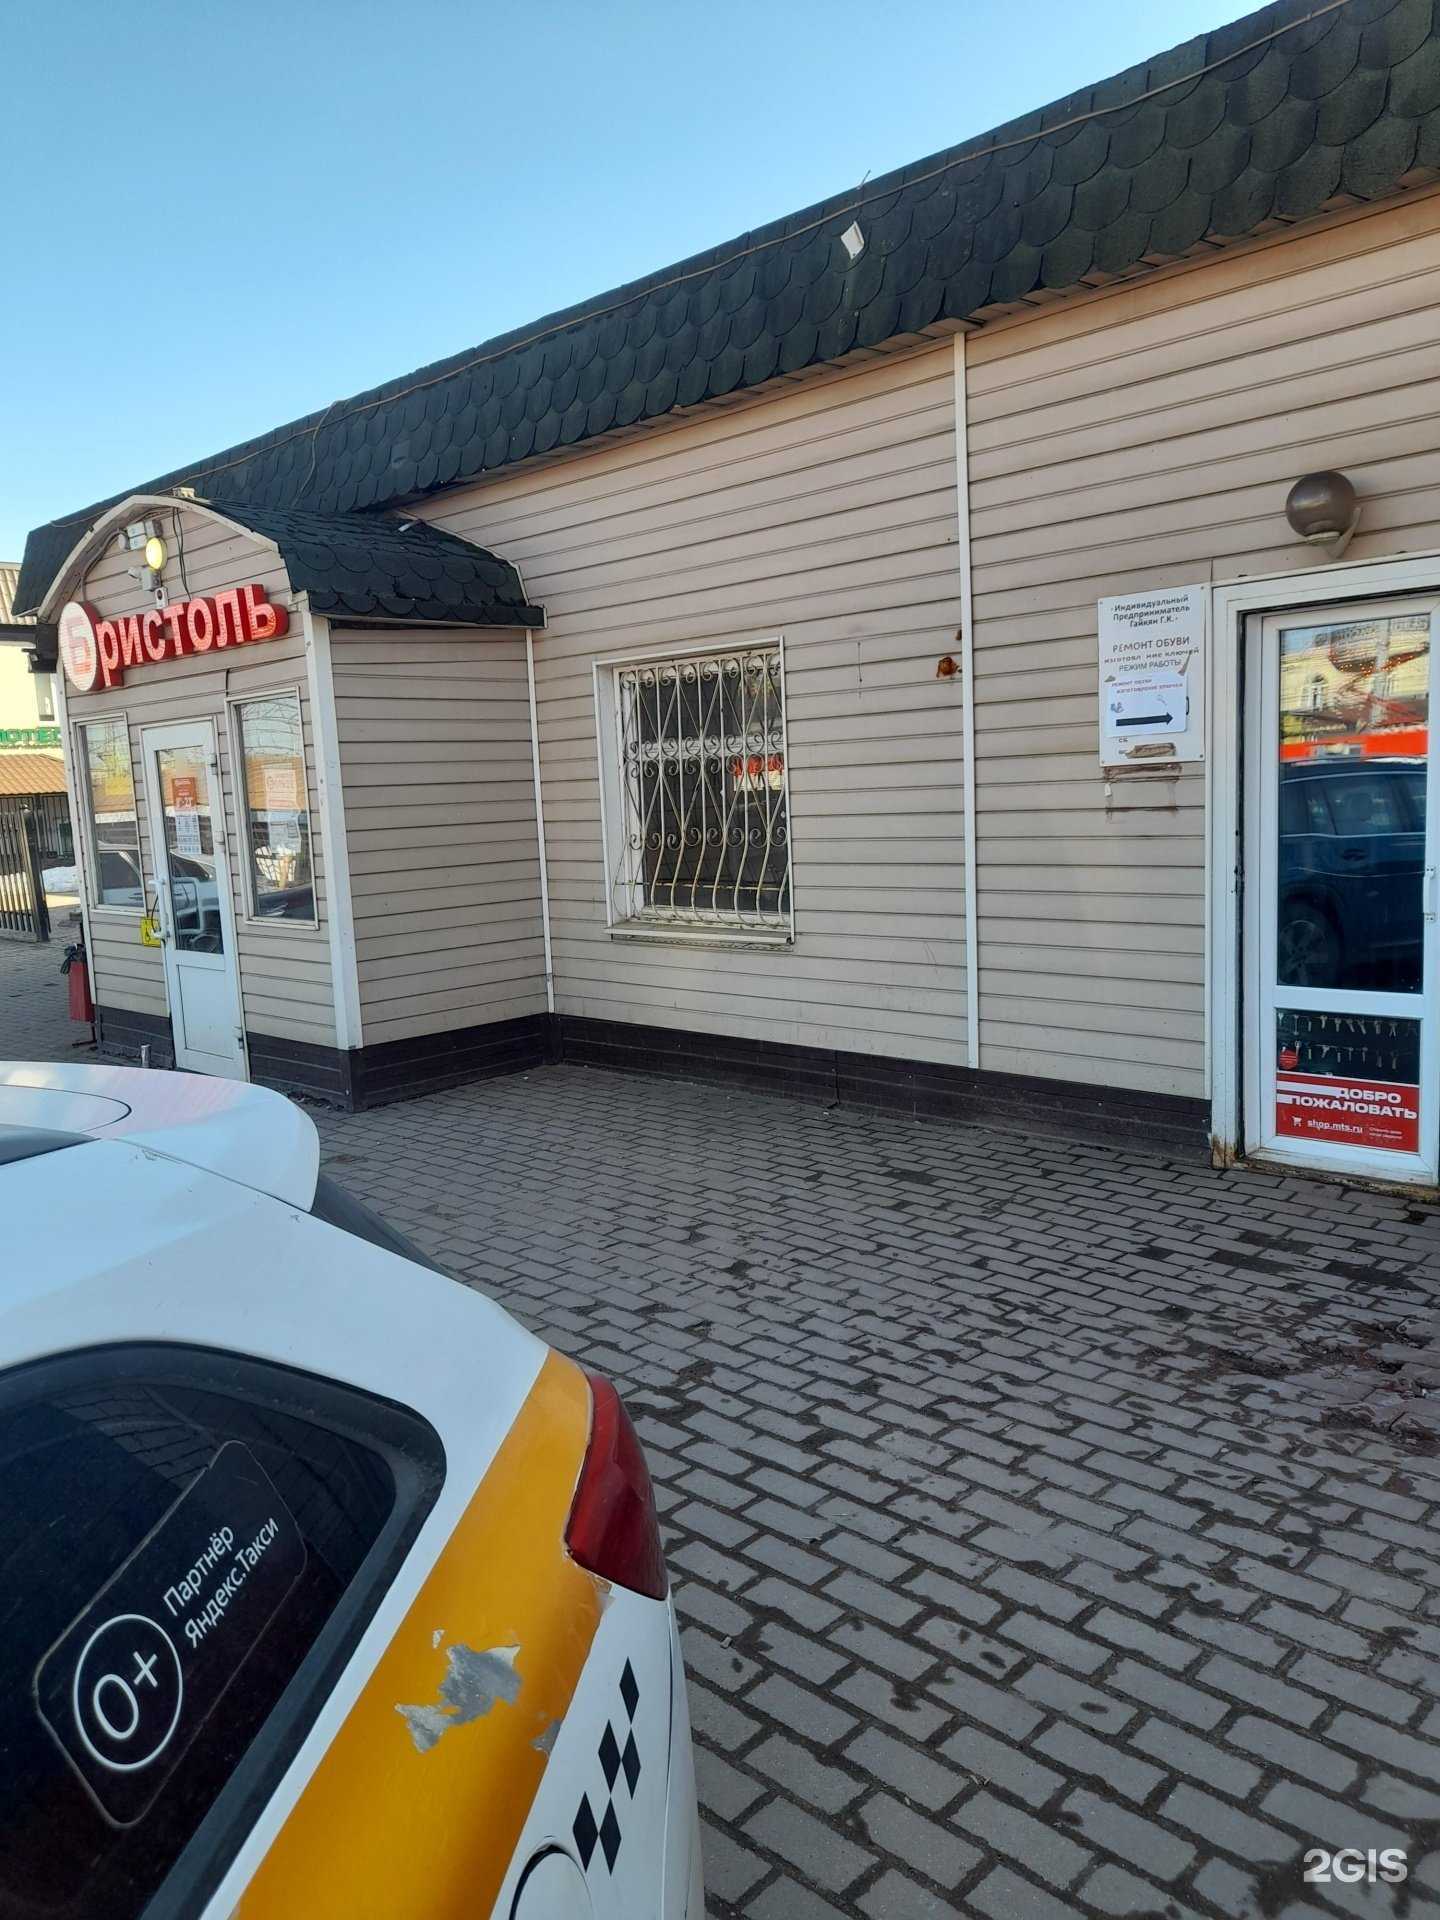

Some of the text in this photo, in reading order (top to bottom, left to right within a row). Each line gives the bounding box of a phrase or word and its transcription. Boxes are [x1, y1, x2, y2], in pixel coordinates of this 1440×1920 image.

[1114, 594, 1189, 612] Индивидуальный
[1113, 605, 1191, 622] Предприниматель
[1112, 636, 1190, 654] РЕМОНТ ОБУВИ
[1119, 659, 1182, 673] РЕЖИМ РАБОТЫ
[1336, 1087, 1402, 1104] ДОБРО
[1291, 1097, 1418, 1120] ПОЖАЛОВАТЬ
[1307, 1119, 1363, 1134] shop.mts.ru
[163, 1526, 234, 1616] Партнёр
[184, 1517, 279, 1649] Яндекс.Такси
[93, 1651, 159, 1740] 0+
